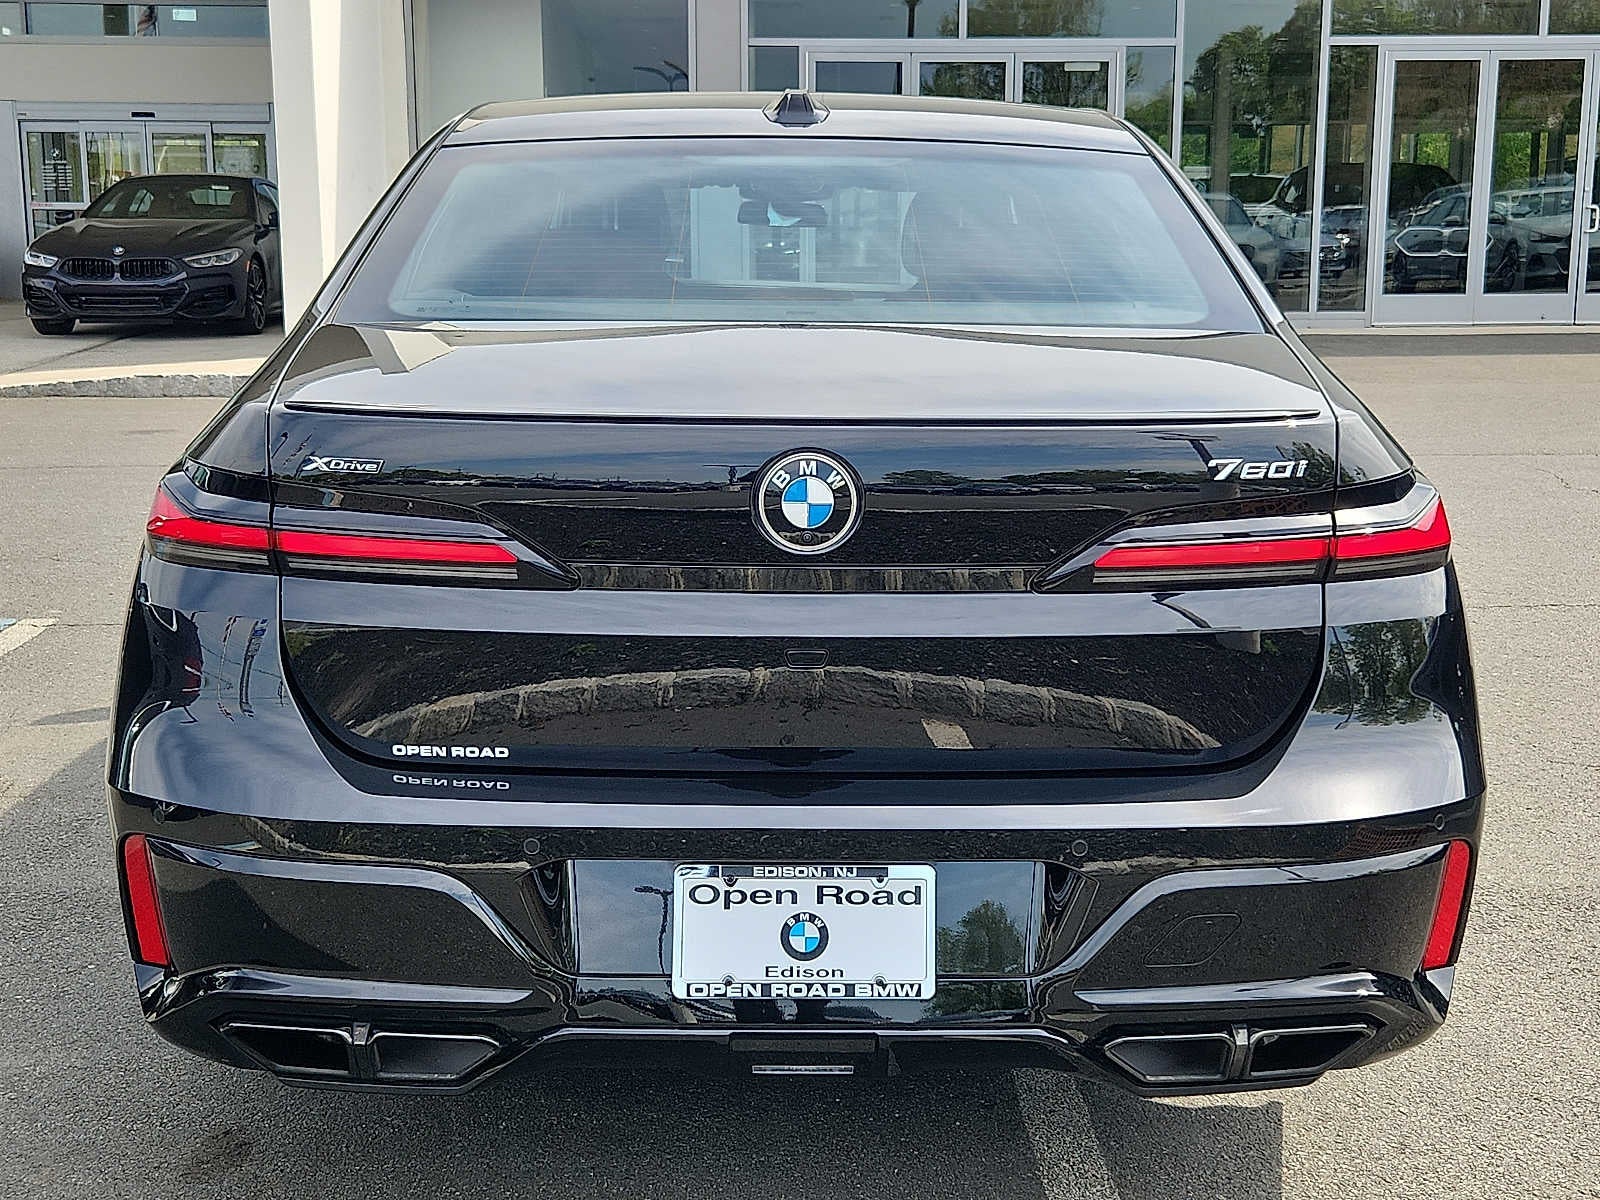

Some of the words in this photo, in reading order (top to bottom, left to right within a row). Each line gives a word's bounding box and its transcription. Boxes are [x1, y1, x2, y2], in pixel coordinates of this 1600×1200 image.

[771, 460, 845, 490] BMW
[1208, 459, 1308, 480] 760i
[392, 744, 447, 757] OPEN
[451, 746, 509, 758] ROAD
[833, 867, 858, 878] NJ
[688, 884, 798, 909] Open
[816, 885, 922, 906] Road
[786, 912, 825, 928] BMW
[765, 965, 845, 978] Edison
[689, 984, 762, 997] OPEN
[770, 984, 846, 997] ROAD
[854, 984, 920, 997] BMW
